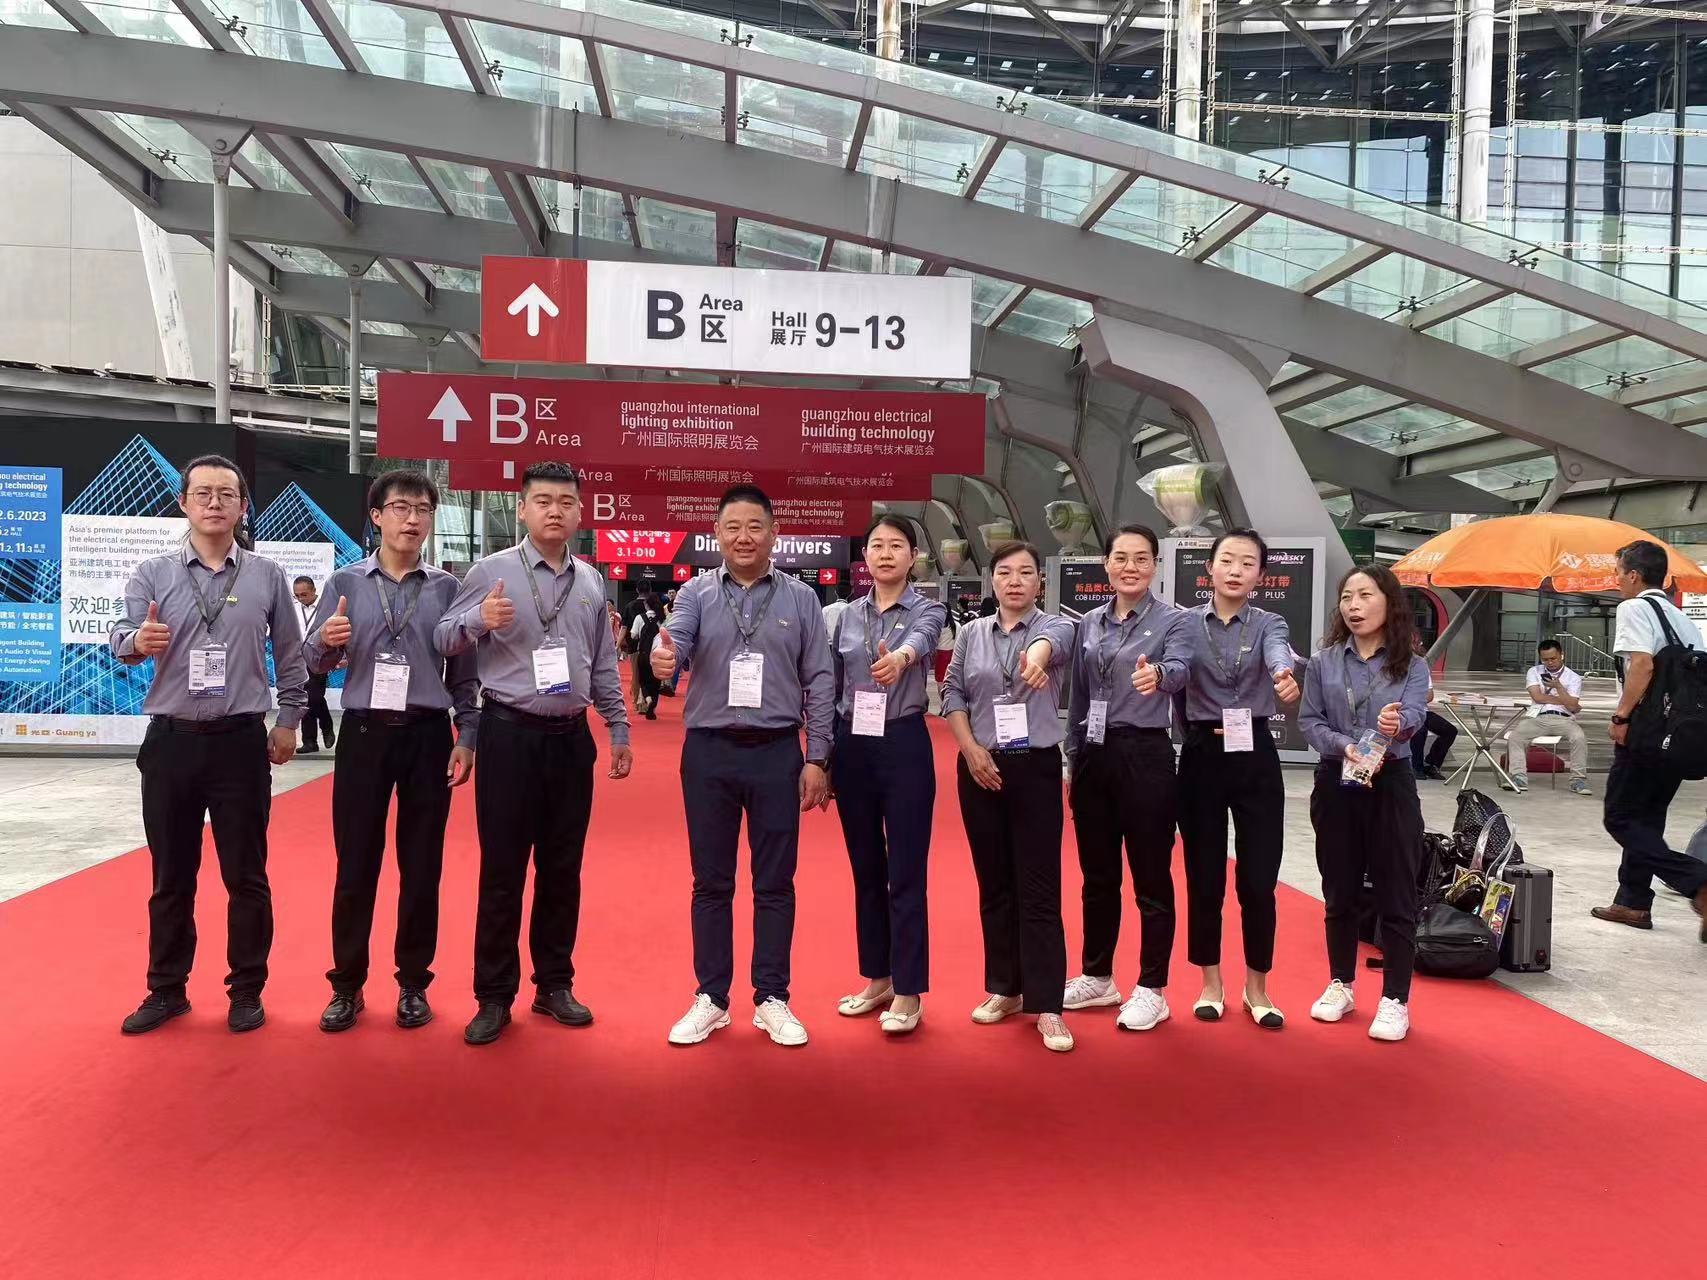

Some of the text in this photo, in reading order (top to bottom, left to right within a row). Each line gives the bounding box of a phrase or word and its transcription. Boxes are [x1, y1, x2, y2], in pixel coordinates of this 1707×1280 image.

[700, 294, 743, 311] Area
[647, 290, 686, 340] B
[701, 314, 727, 343] 区
[772, 311, 906, 350] Hall 9-13
[771, 329, 806, 346] 展厅
[535, 398, 557, 420] 区
[621, 400, 760, 416] guangzhou international
[490, 393, 529, 444] B
[621, 414, 733, 430] lighting exhibition
[801, 408, 932, 423] guangzhou electrical
[536, 430, 581, 446] Area
[801, 423, 935, 442] building technology
[621, 431, 759, 450] 广州国际照明展览会
[801, 442, 935, 455] 广州国际建筑电气技术展览会
[12, 472, 46, 481] electrical
[578, 468, 613, 482] Area
[644, 469, 754, 483] 广州国际照明展览会
[5, 482, 48, 492] technology
[593, 493, 616, 521] B
[619, 494, 631, 507] 区
[666, 503, 693, 512] lighting
[809, 500, 843, 508] electrical
[619, 512, 645, 522] Area
[772, 508, 844, 519] uilding technology
[69, 525, 170, 536] Asia's premier platform for
[83, 536, 118, 544] electrical
[120, 537, 165, 546] engineering
[167, 538, 181, 546] and
[69, 545, 107, 555] intelligent
[109, 546, 139, 555] building
[617, 547, 656, 558] 3.1-D10
[69, 569, 130, 580] 市场的主要平台
[1195, 590, 1214, 599] COB
[1265, 591, 1286, 599] PLUS
[56, 729, 84, 737] Guang
